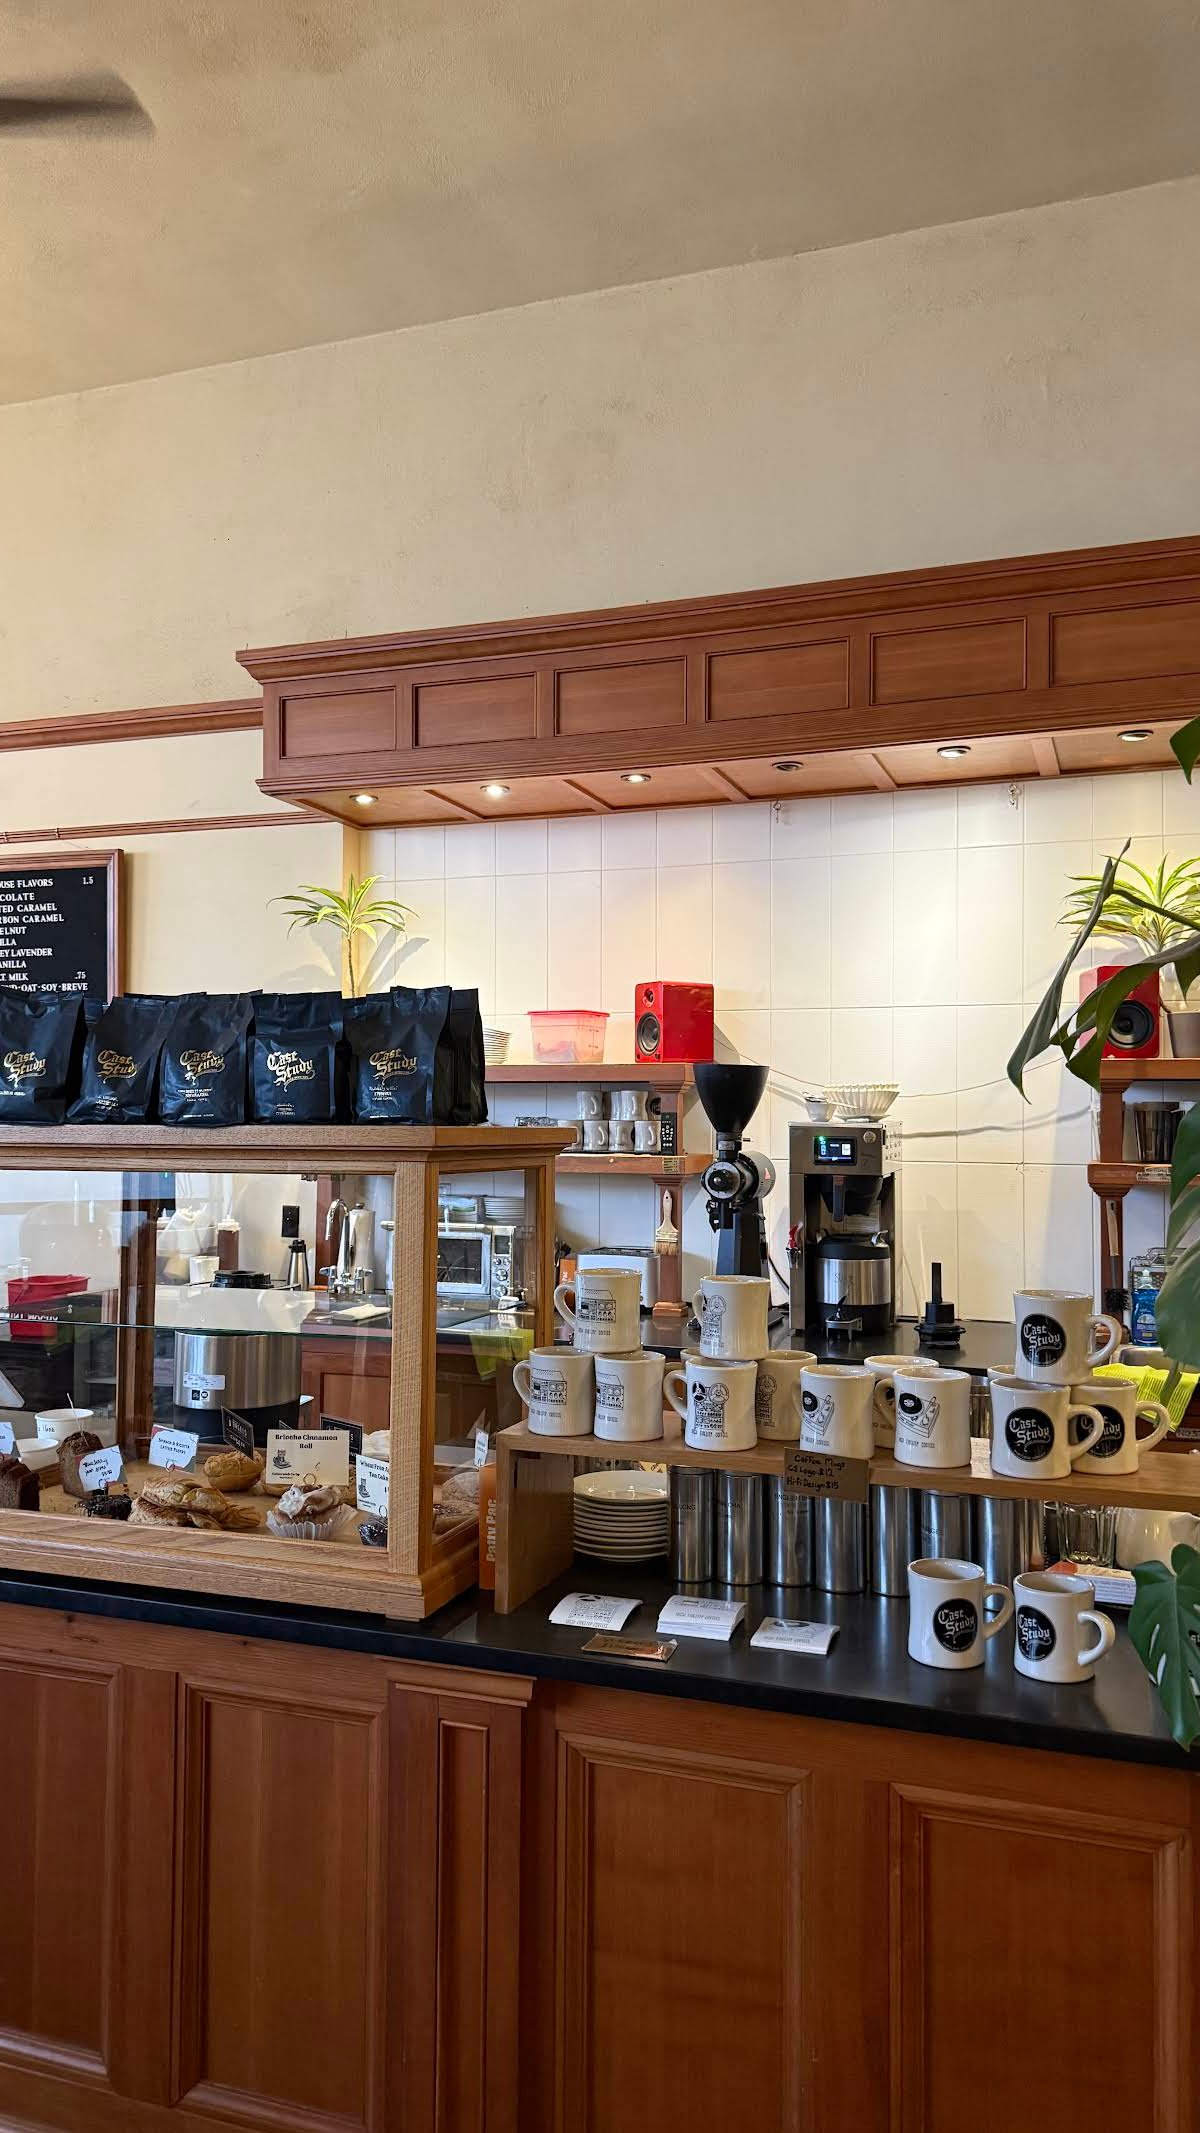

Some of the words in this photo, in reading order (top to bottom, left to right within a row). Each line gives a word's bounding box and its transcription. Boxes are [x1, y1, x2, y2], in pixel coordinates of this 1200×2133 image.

[0, 880, 15, 888] USE
[17, 879, 53, 888] FLAVORS
[83, 877, 94, 885] 1.5
[17, 903, 57, 912] CARAMEL
[22, 914, 64, 923] CARAMEL
[11, 948, 53, 957] LAVENDER
[8, 972, 29, 981] MILK
[75, 971, 86, 980] .75
[4, 1051, 35, 1067] Case
[98, 1050, 133, 1064] Case
[180, 1050, 213, 1066] Case
[267, 1051, 298, 1070] Case
[369, 1048, 402, 1066] Case
[9, 1057, 46, 1079] Study
[274, 1057, 315, 1081] Study
[374, 1054, 417, 1078] Study
[1023, 1323, 1048, 1338] Case
[1028, 1331, 1062, 1349] Study
[1009, 1417, 1037, 1432] Case
[1014, 1425, 1050, 1444] Study
[794, 1454, 822, 1465] Coffee
[824, 1457, 846, 1471] Mugs
[938, 1609, 965, 1624] Case
[1018, 1614, 1037, 1628] Case
[944, 1615, 975, 1635] Study
[1021, 1625, 1051, 1641] Study
